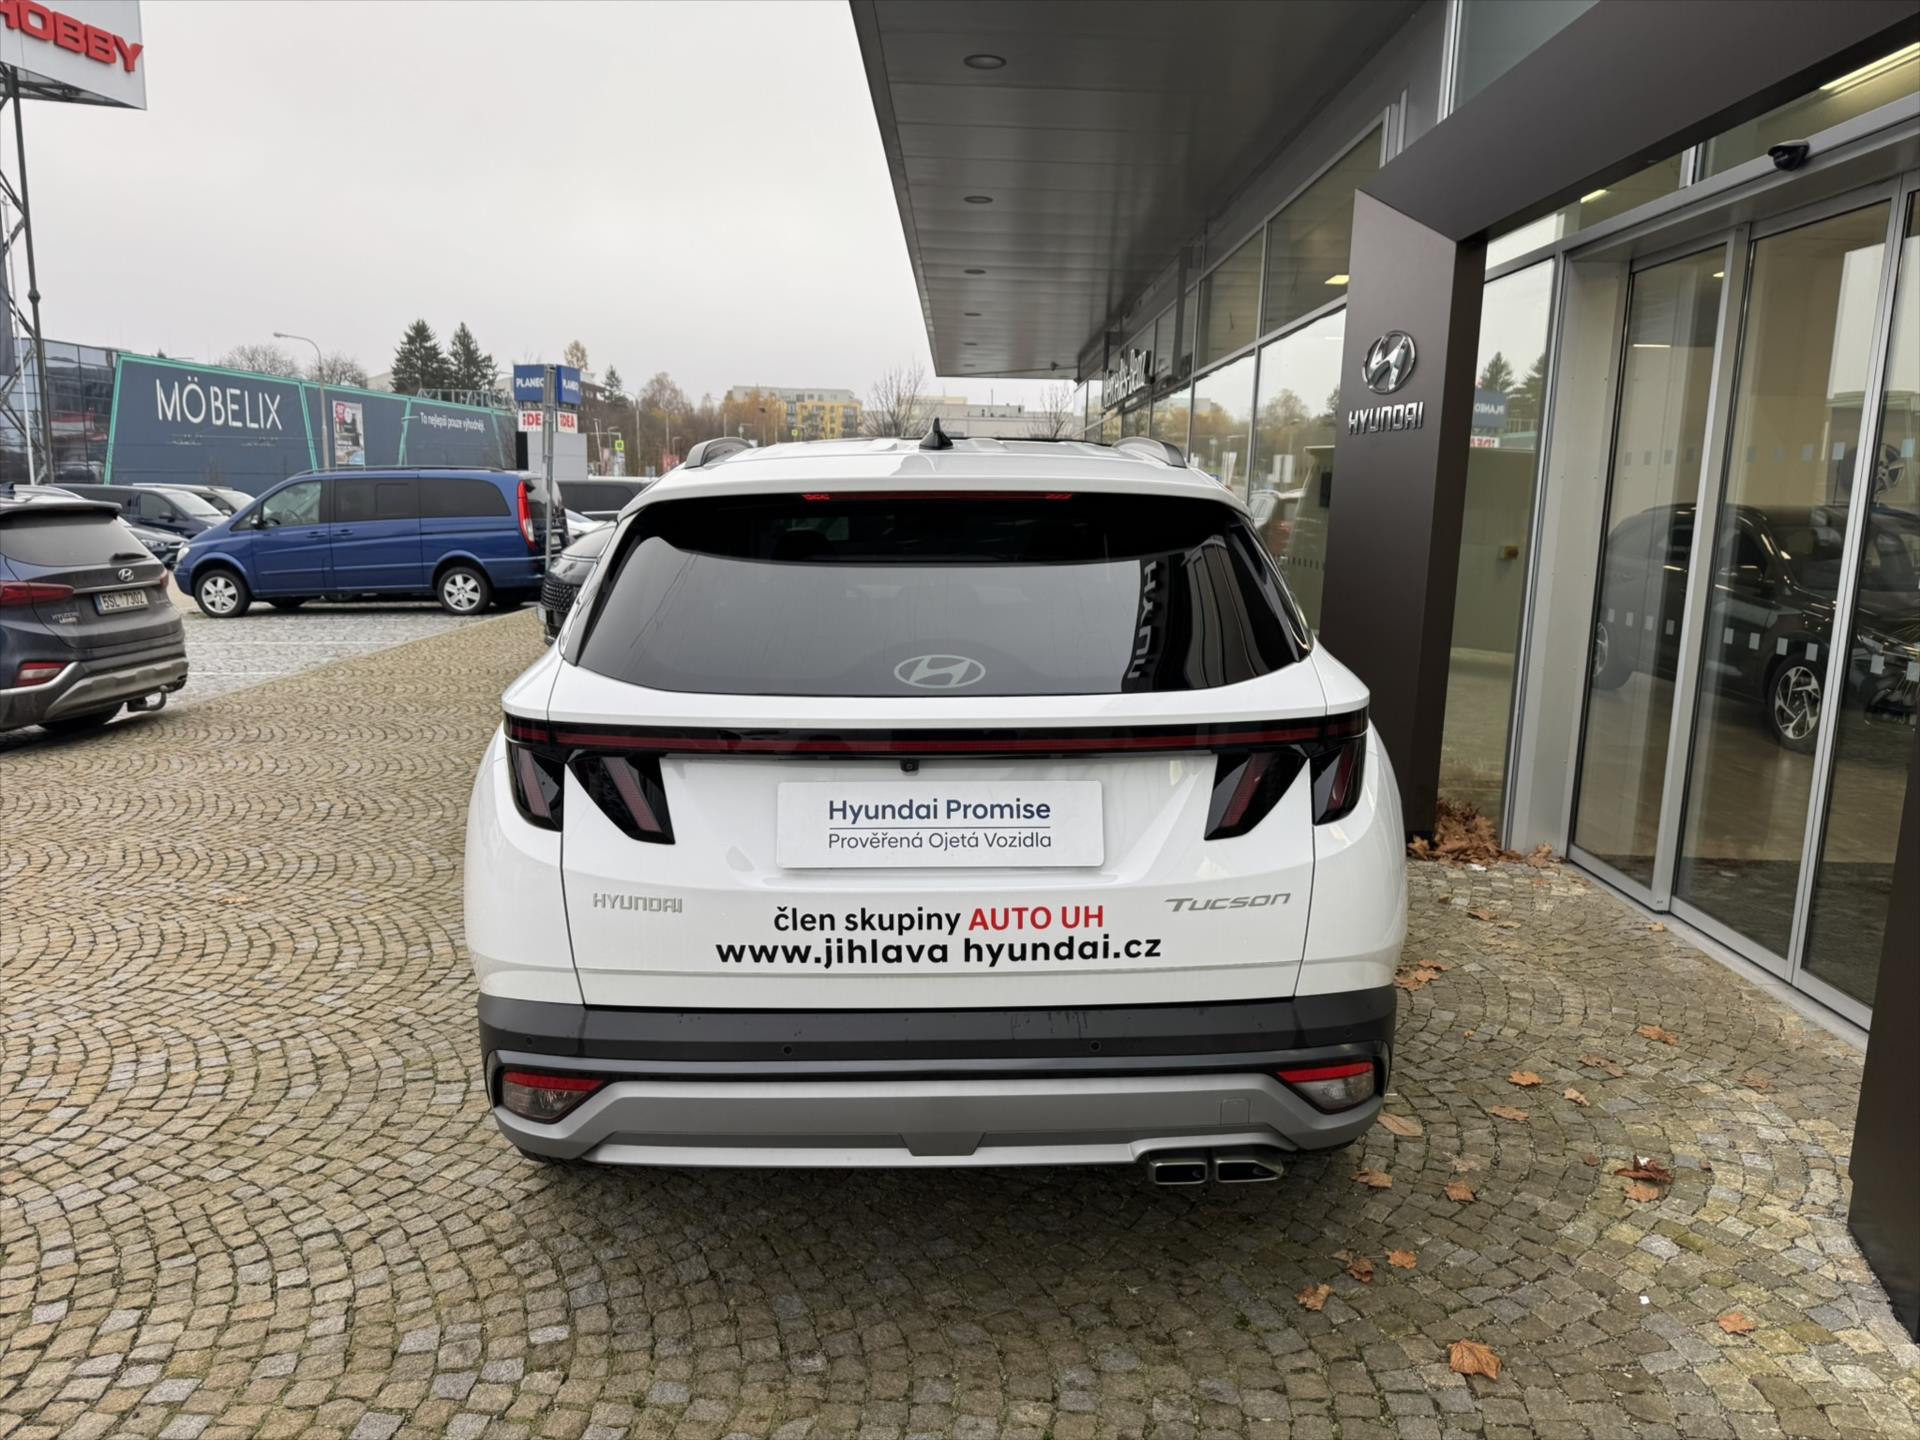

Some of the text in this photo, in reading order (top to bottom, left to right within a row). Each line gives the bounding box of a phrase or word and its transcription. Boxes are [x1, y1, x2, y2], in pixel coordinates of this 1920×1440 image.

[156, 375, 282, 430] MÖBELIX
[1348, 401, 1423, 434] HYUNDAI
[828, 797, 1051, 824] Hyundai Promise
[828, 831, 1051, 851] Prověřená Ojetá Vozidla
[593, 893, 683, 913] HYUNDAI
[774, 905, 1104, 936] člen skupiny AUTO UH
[715, 934, 1162, 969] www.jihlava hyundai.cz
